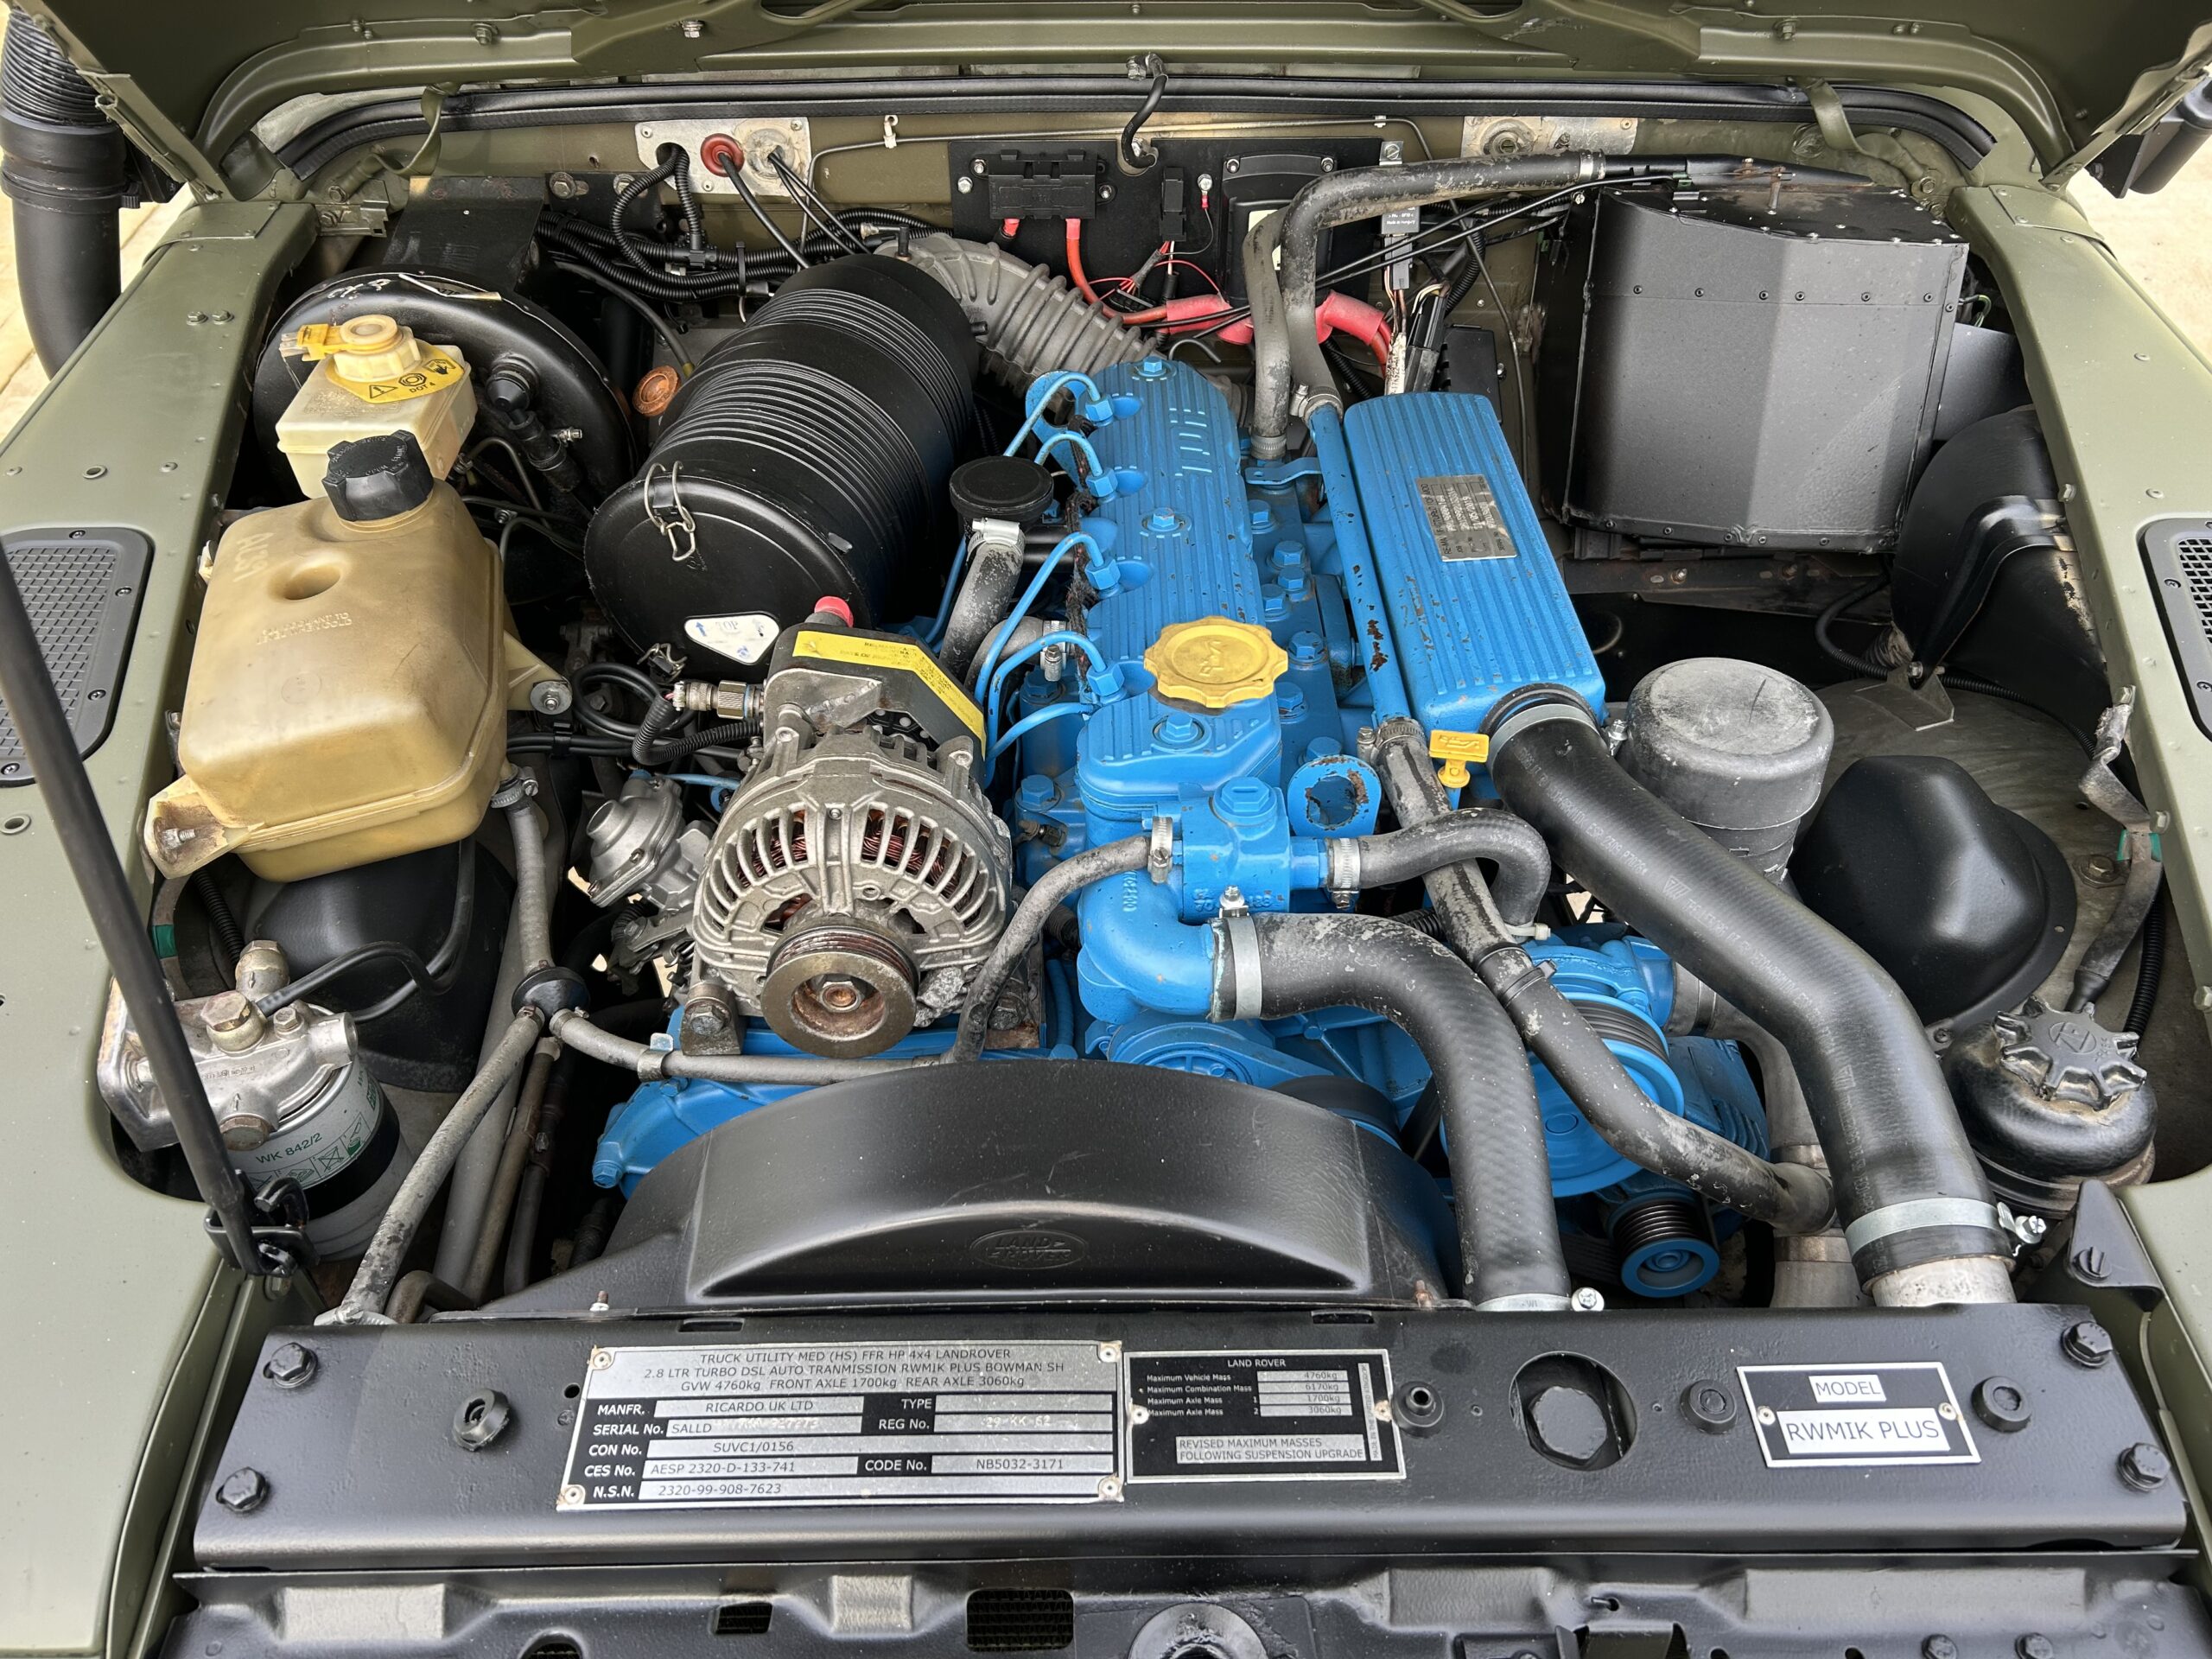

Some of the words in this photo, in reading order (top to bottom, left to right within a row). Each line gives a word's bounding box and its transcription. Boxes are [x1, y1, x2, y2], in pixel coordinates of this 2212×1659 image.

[410, 384, 428, 392] DOT
[715, 620, 739, 631] TOP
[256, 1150, 282, 1165] WK
[285, 1132, 323, 1158] 842/2
[701, 1353, 741, 1363] TRUCK
[747, 1353, 793, 1362] UTILITY
[798, 1352, 825, 1361] MED
[830, 1350, 857, 1362] (HS)
[862, 1350, 883, 1359] FFR
[888, 1350, 904, 1358] HP
[909, 1349, 931, 1358] 4x4
[937, 1349, 1010, 1358] LANDROVER
[645, 1369, 664, 1378] 2.8
[669, 1368, 689, 1377] LTR
[695, 1368, 735, 1376] TURBO
[741, 1366, 766, 1376] DSL
[770, 1366, 804, 1376] AUTO
[808, 1363, 896, 1375] TRANMISSION
[950, 1363, 980, 1371] PLUS
[985, 1362, 1042, 1371] BOWMAN
[1047, 1362, 1064, 1371] SH
[1305, 1372, 1338, 1381] 4760kg
[682, 1382, 710, 1391] GVW
[715, 1381, 760, 1392] 4760kg
[770, 1380, 810, 1389] FRONT
[816, 1378, 846, 1389] AXLE
[852, 1377, 897, 1389] 1700kg
[906, 1377, 938, 1386] REAR
[944, 1376, 974, 1386] AXLE
[980, 1376, 1024, 1388] 3060kg
[1306, 1383, 1338, 1392] 6170kg
[1815, 1382, 1881, 1395] MODEL
[598, 1404, 645, 1415] MANFR.
[706, 1402, 764, 1412] RICARDO
[769, 1402, 787, 1411] UK
[791, 1402, 813, 1411] LTD
[901, 1399, 931, 1409] TYPE
[1308, 1406, 1342, 1414] 3060kg
[594, 1425, 639, 1435] SERIAL
[643, 1424, 664, 1434] No.
[671, 1424, 712, 1433] SALLD
[879, 1420, 905, 1429] REG
[909, 1419, 930, 1429] No.
[1786, 1422, 1874, 1440] RWMIK
[1879, 1421, 1939, 1439] PLUS
[714, 1442, 793, 1453] SUVC1/0156
[1180, 1439, 1224, 1448] REVISED
[1227, 1439, 1278, 1447] MAXIMUM
[1281, 1438, 1322, 1446] MASSES
[588, 1445, 617, 1455] CON
[621, 1444, 642, 1454] No.
[1180, 1451, 1242, 1461] FOLLOWING
[1245, 1450, 1310, 1459] SUSPENSION
[1315, 1449, 1363, 1459] UPGRADE
[651, 1463, 684, 1474] AESP
[689, 1462, 795, 1473] 2320-D-133-741
[865, 1459, 901, 1471] CODE
[906, 1459, 926, 1471] No.
[976, 1459, 1064, 1469] NB5032-3171
[584, 1465, 610, 1477] CES
[614, 1465, 635, 1476] No.
[594, 1487, 634, 1497] N.S.N.
[658, 1484, 781, 1496] 2320-99-908-7623
